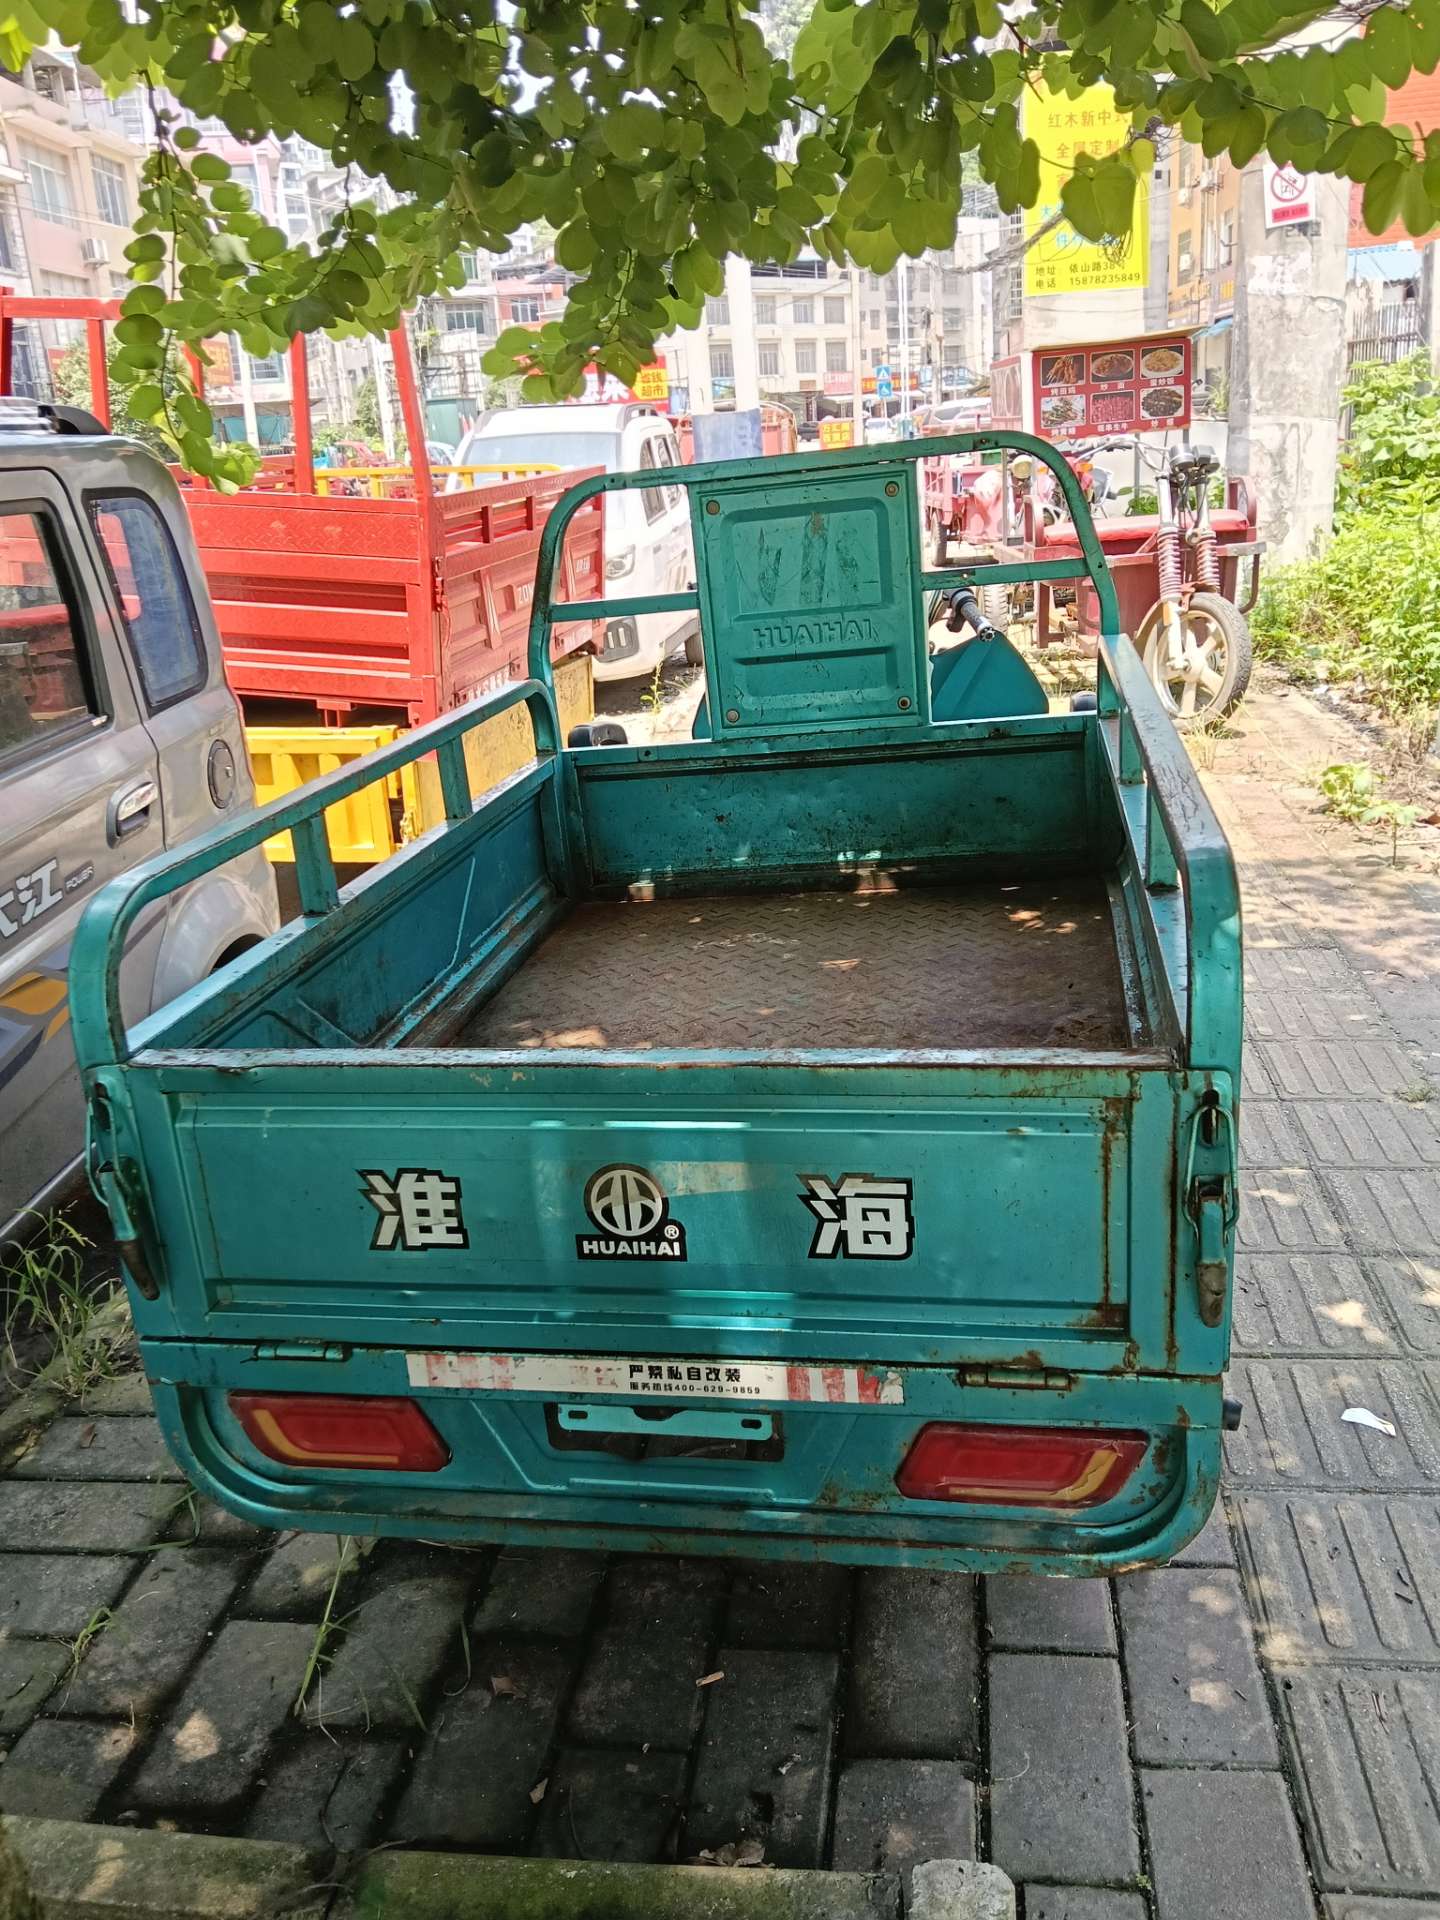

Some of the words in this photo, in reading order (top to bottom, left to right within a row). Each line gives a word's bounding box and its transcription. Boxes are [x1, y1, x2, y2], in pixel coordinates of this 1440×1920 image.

[641, 385, 664, 397] 超市
[753, 618, 872, 650] HUAIHAI
[360, 1170, 467, 1249] 淮
[804, 1176, 911, 1257] 海
[583, 1240, 681, 1257] HUAIHAI
